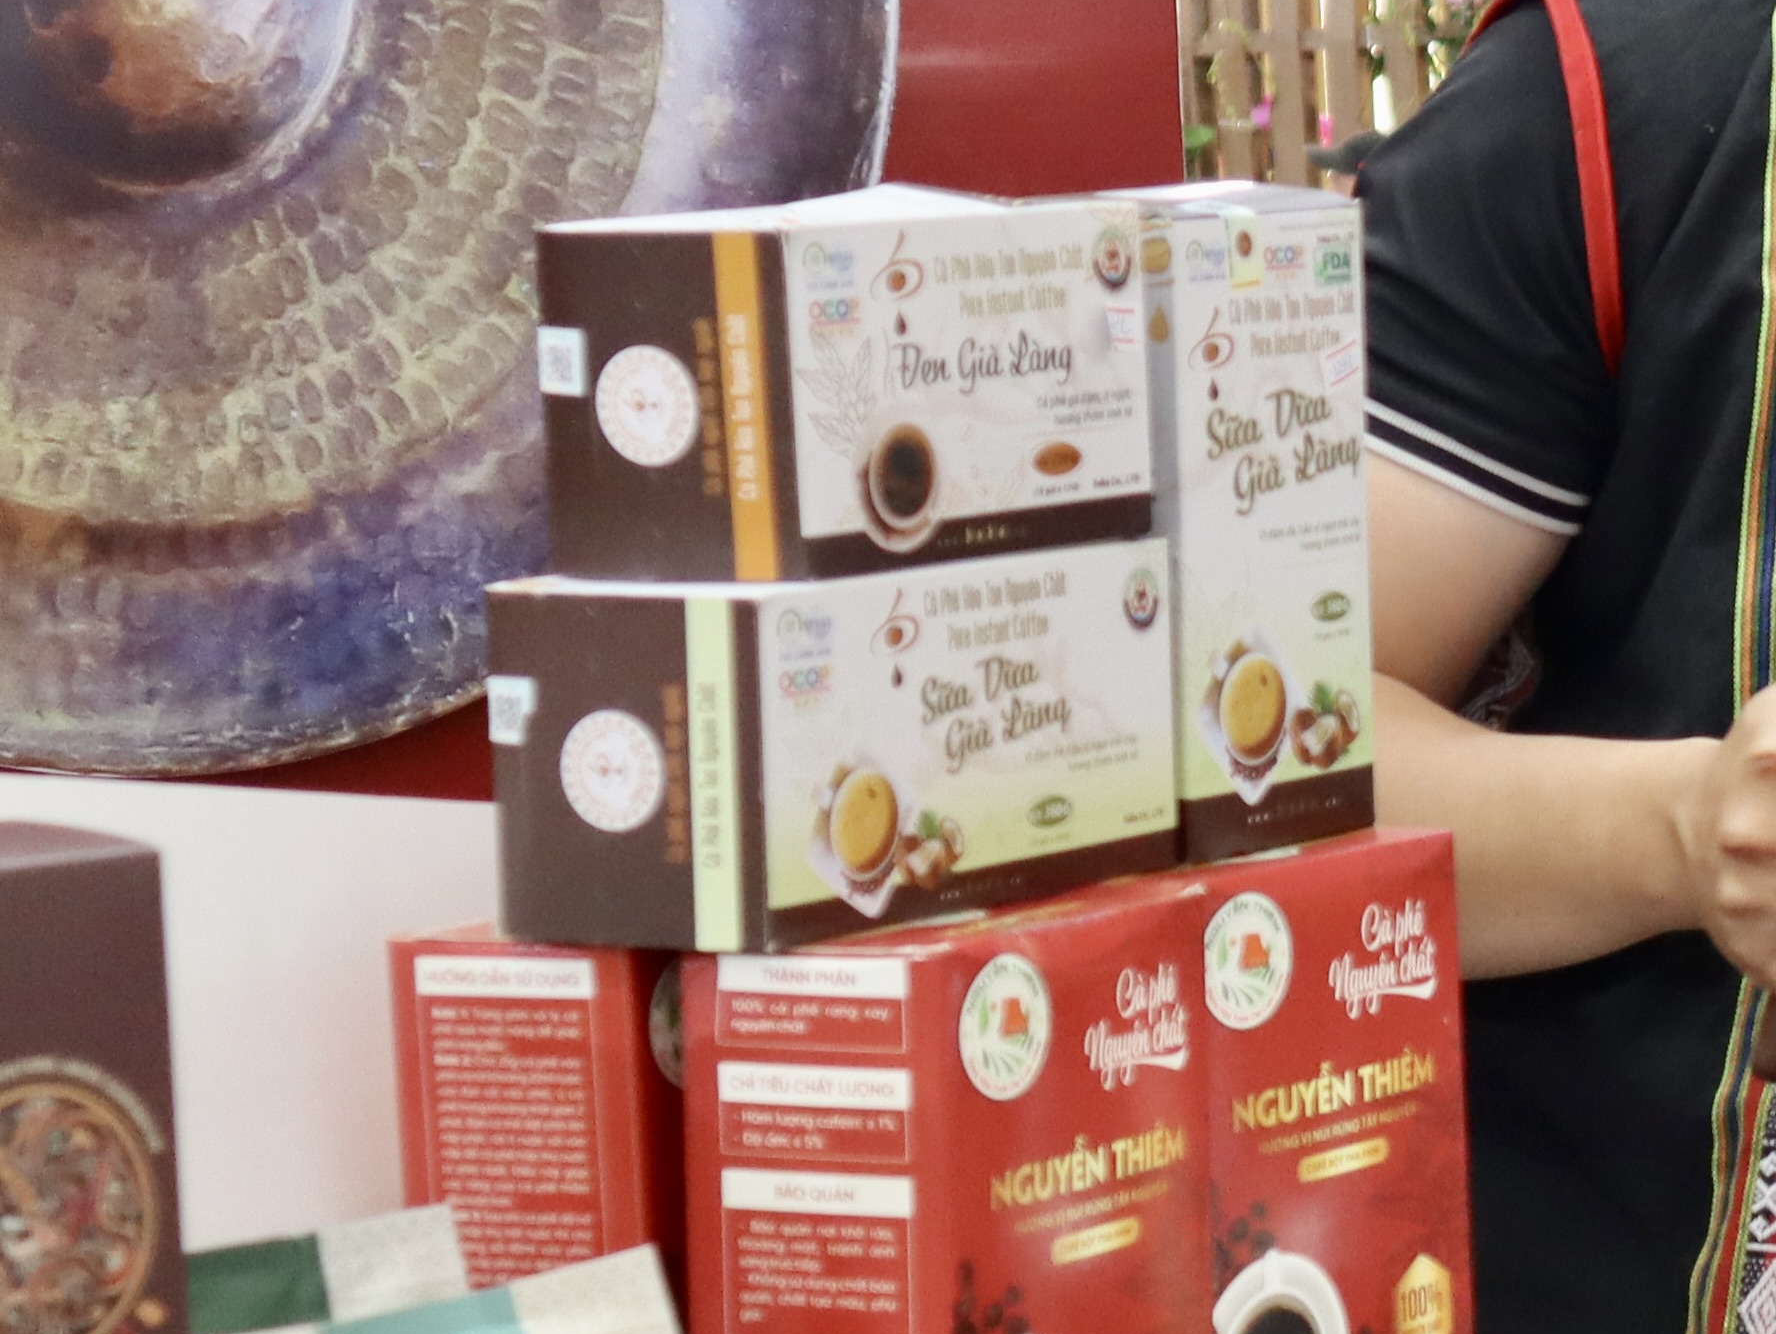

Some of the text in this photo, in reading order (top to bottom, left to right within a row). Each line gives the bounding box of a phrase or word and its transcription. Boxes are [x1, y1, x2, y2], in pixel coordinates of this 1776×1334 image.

[1361, 897, 1424, 957] Cà phê
[1116, 963, 1177, 1023] Cà phê
[1328, 935, 1435, 1019] Nguyên chất
[1084, 1018, 1150, 1091] Nguyên
[1401, 1282, 1443, 1322] 100%
